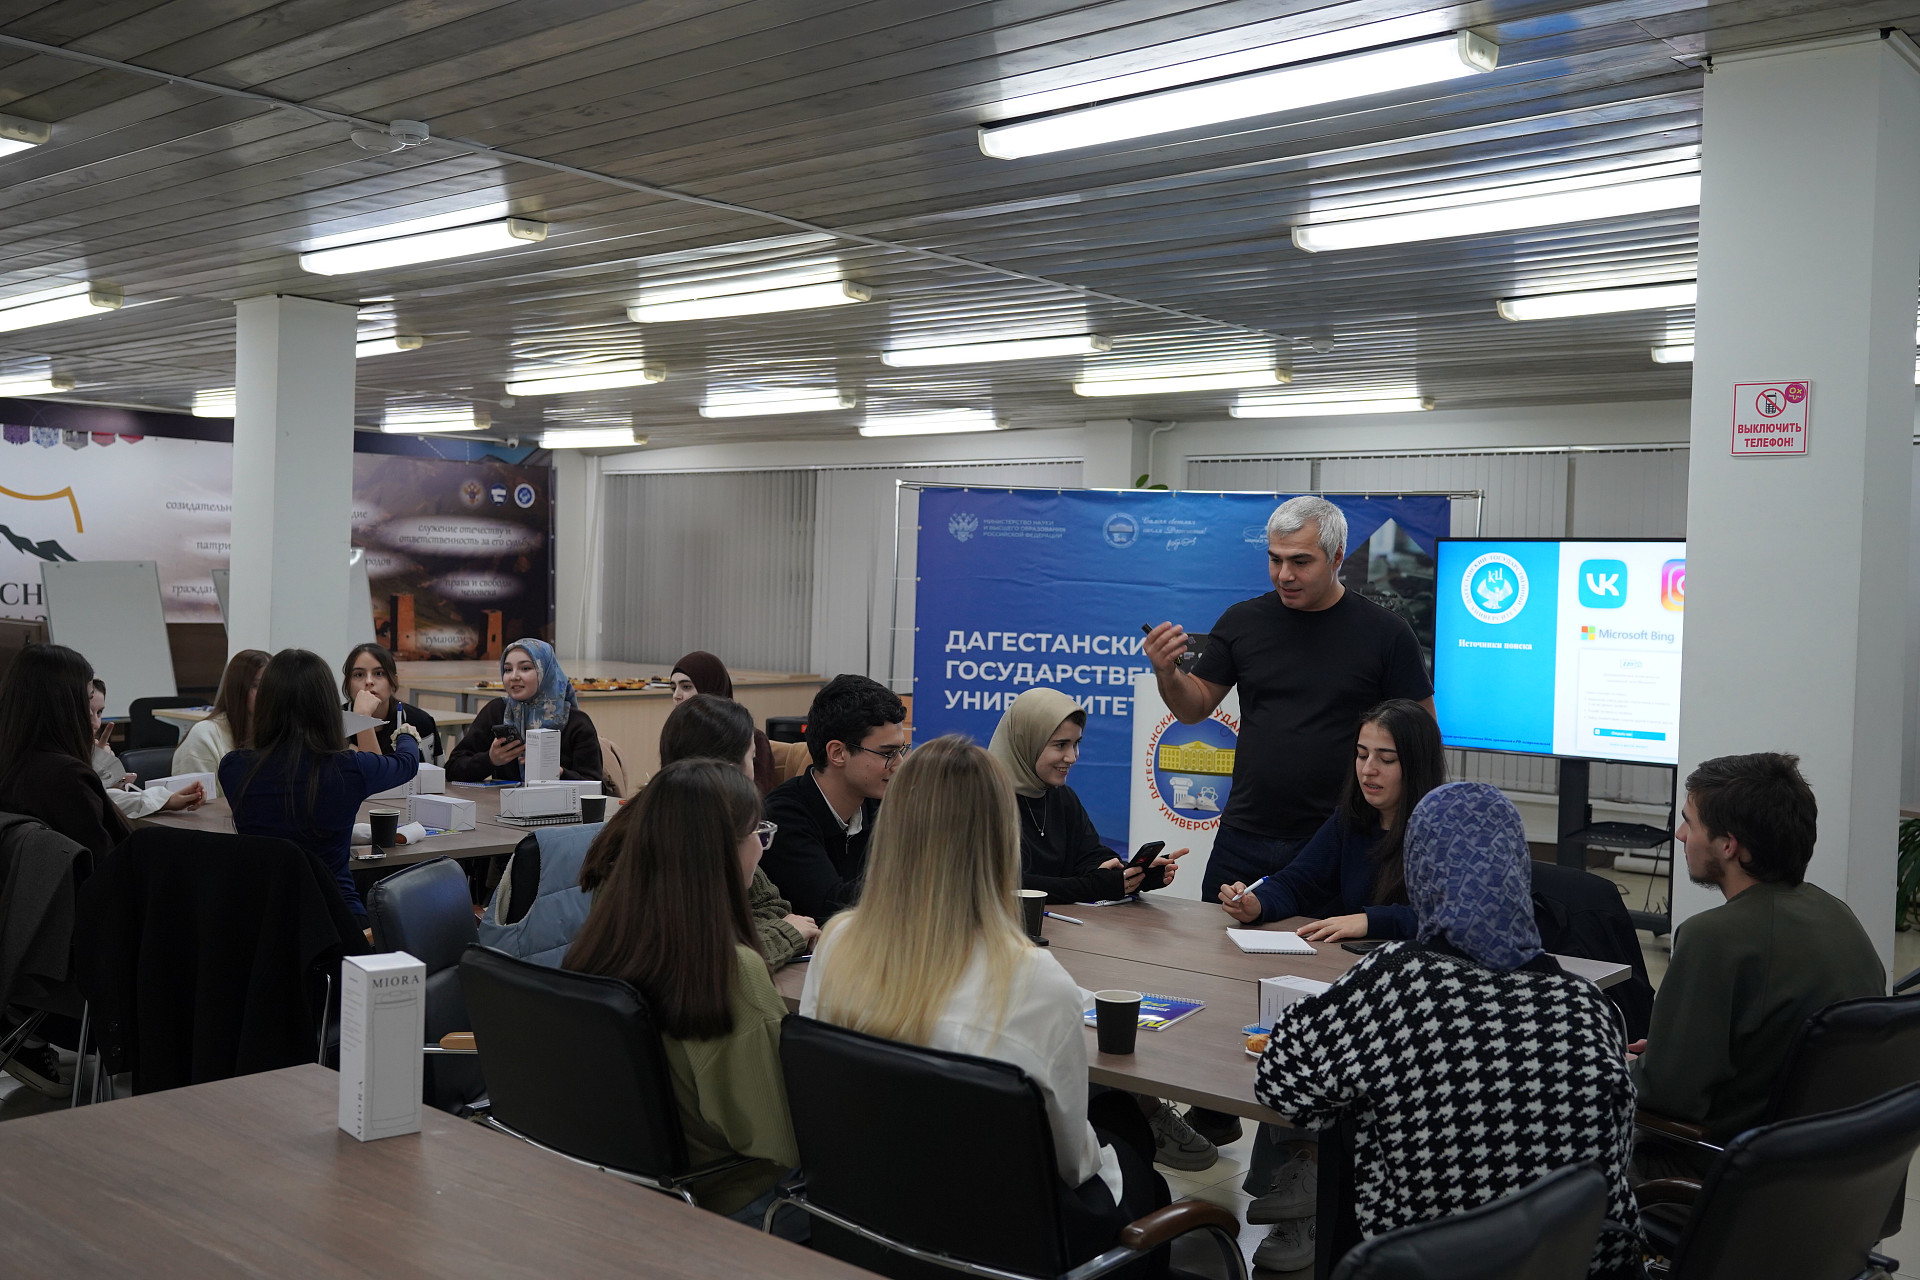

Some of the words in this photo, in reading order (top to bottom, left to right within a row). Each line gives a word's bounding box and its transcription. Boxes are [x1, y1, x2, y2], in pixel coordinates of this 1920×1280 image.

[1737, 423, 1802, 434] ВЫКЛЮЧИТЬ
[1744, 437, 1794, 448] ТЕЛЕФОН!
[418, 524, 457, 535] служение
[459, 526, 504, 538] отечеству
[399, 535, 479, 546] ответственность
[1586, 573, 1620, 596] VK
[1599, 629, 1648, 641] Microsoft
[1651, 631, 1675, 644] Bing
[1459, 639, 1502, 649] Источники
[946, 660, 1150, 685] ГОСУДАРСТВЕ
[1158, 803, 1221, 831] УНИВЕРСИ
[372, 974, 420, 989] MIORA
